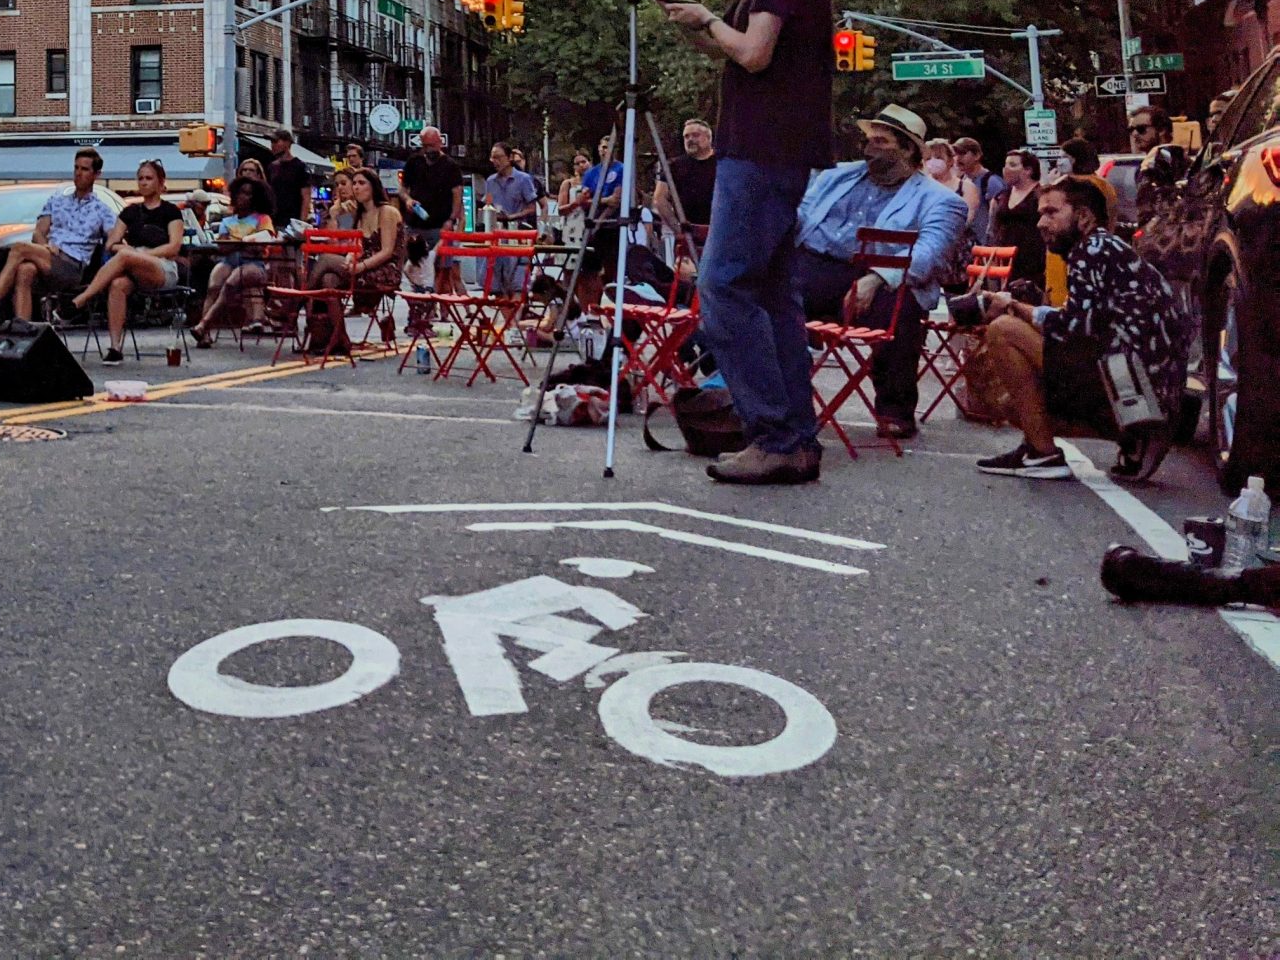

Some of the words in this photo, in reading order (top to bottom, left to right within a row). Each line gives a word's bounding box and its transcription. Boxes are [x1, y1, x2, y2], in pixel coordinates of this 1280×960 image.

[923, 64, 937, 75] 34
[941, 63, 953, 74] St
[1147, 57, 1161, 70] 34
[1106, 81, 1127, 90] ONE
